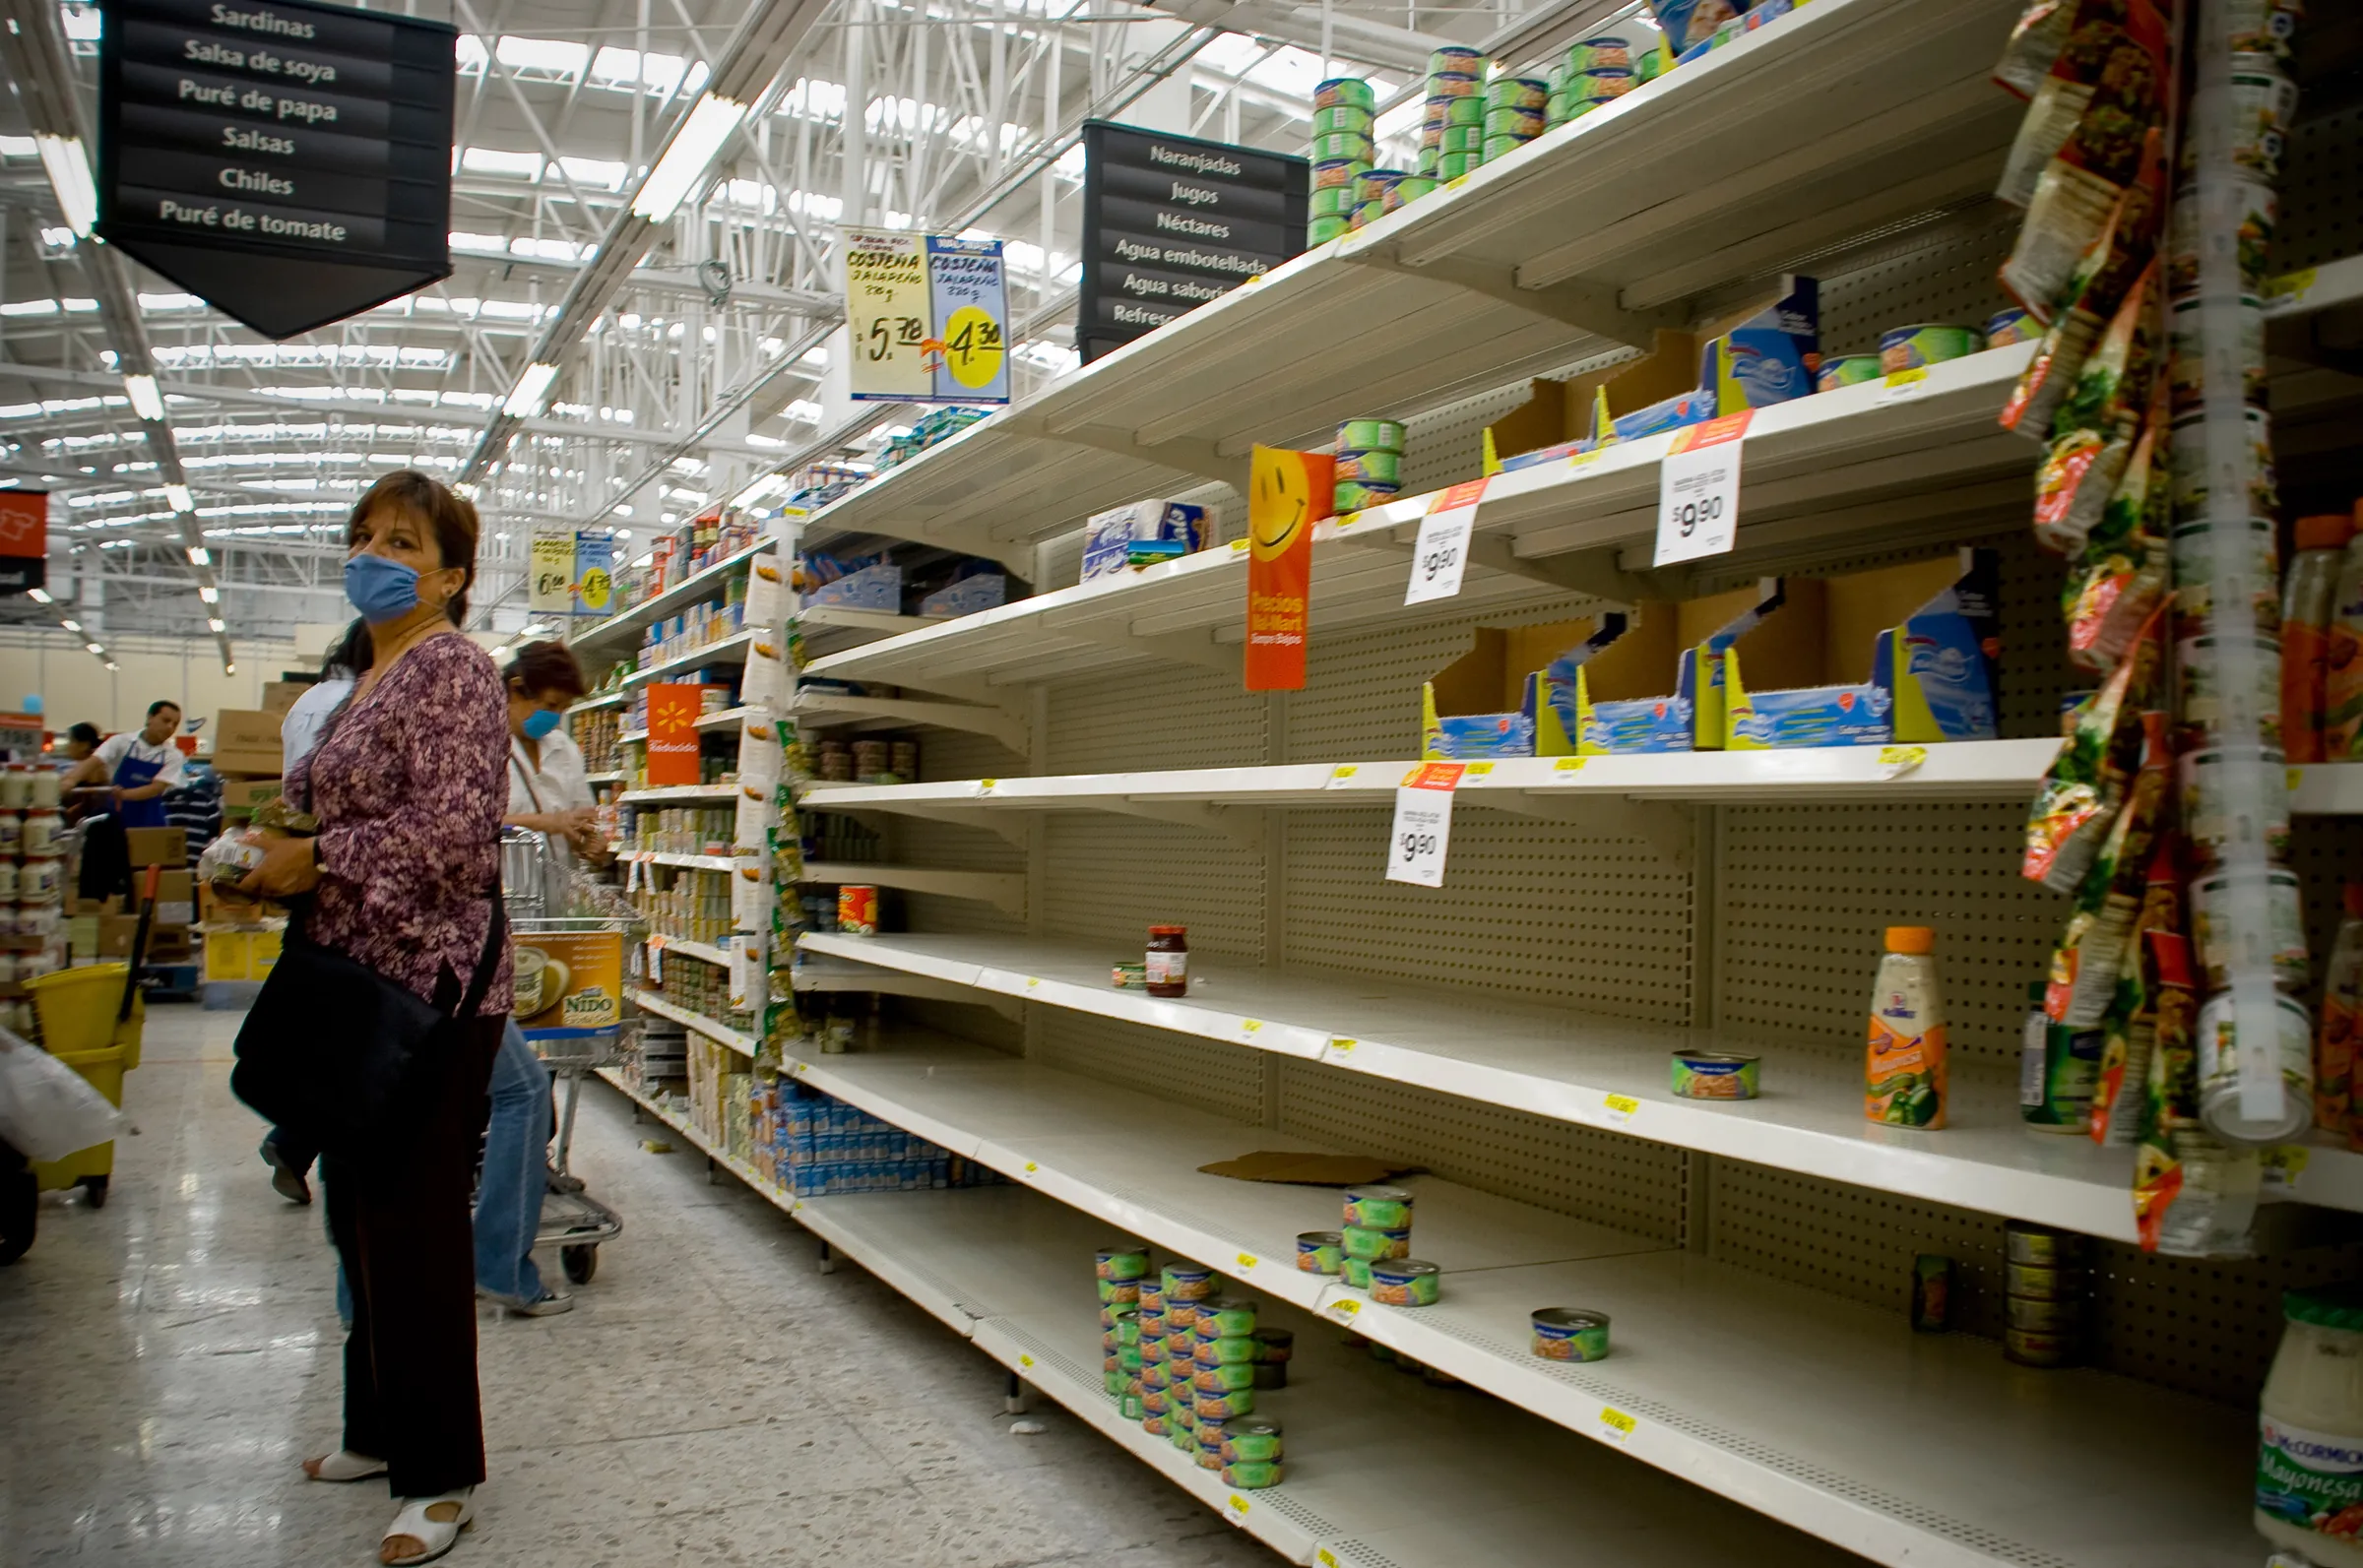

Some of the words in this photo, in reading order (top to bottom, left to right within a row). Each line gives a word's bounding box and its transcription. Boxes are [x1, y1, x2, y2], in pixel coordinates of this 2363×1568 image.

[211, 4, 315, 39] Sardinas
[184, 39, 244, 67] Salsa
[249, 51, 281, 73] de
[285, 60, 336, 84] soya
[179, 79, 236, 105] Puré
[240, 90, 274, 111] de
[278, 97, 337, 123] papa
[223, 127, 295, 155] Salsas
[1150, 146, 1242, 175] Naranjadas
[219, 168, 294, 195] Chiles
[1170, 181, 1219, 205] Jugos
[160, 200, 219, 225] Puré
[223, 209, 256, 230] de
[259, 214, 347, 241] tomate
[1156, 212, 1230, 238] Néctares
[1115, 238, 1161, 261] Agua
[1163, 249, 1269, 276] embotellada
[1122, 273, 1169, 295] Agua
[564, 997, 613, 1013] NIDO
[2262, 1450, 2362, 1500] Mayonesa
